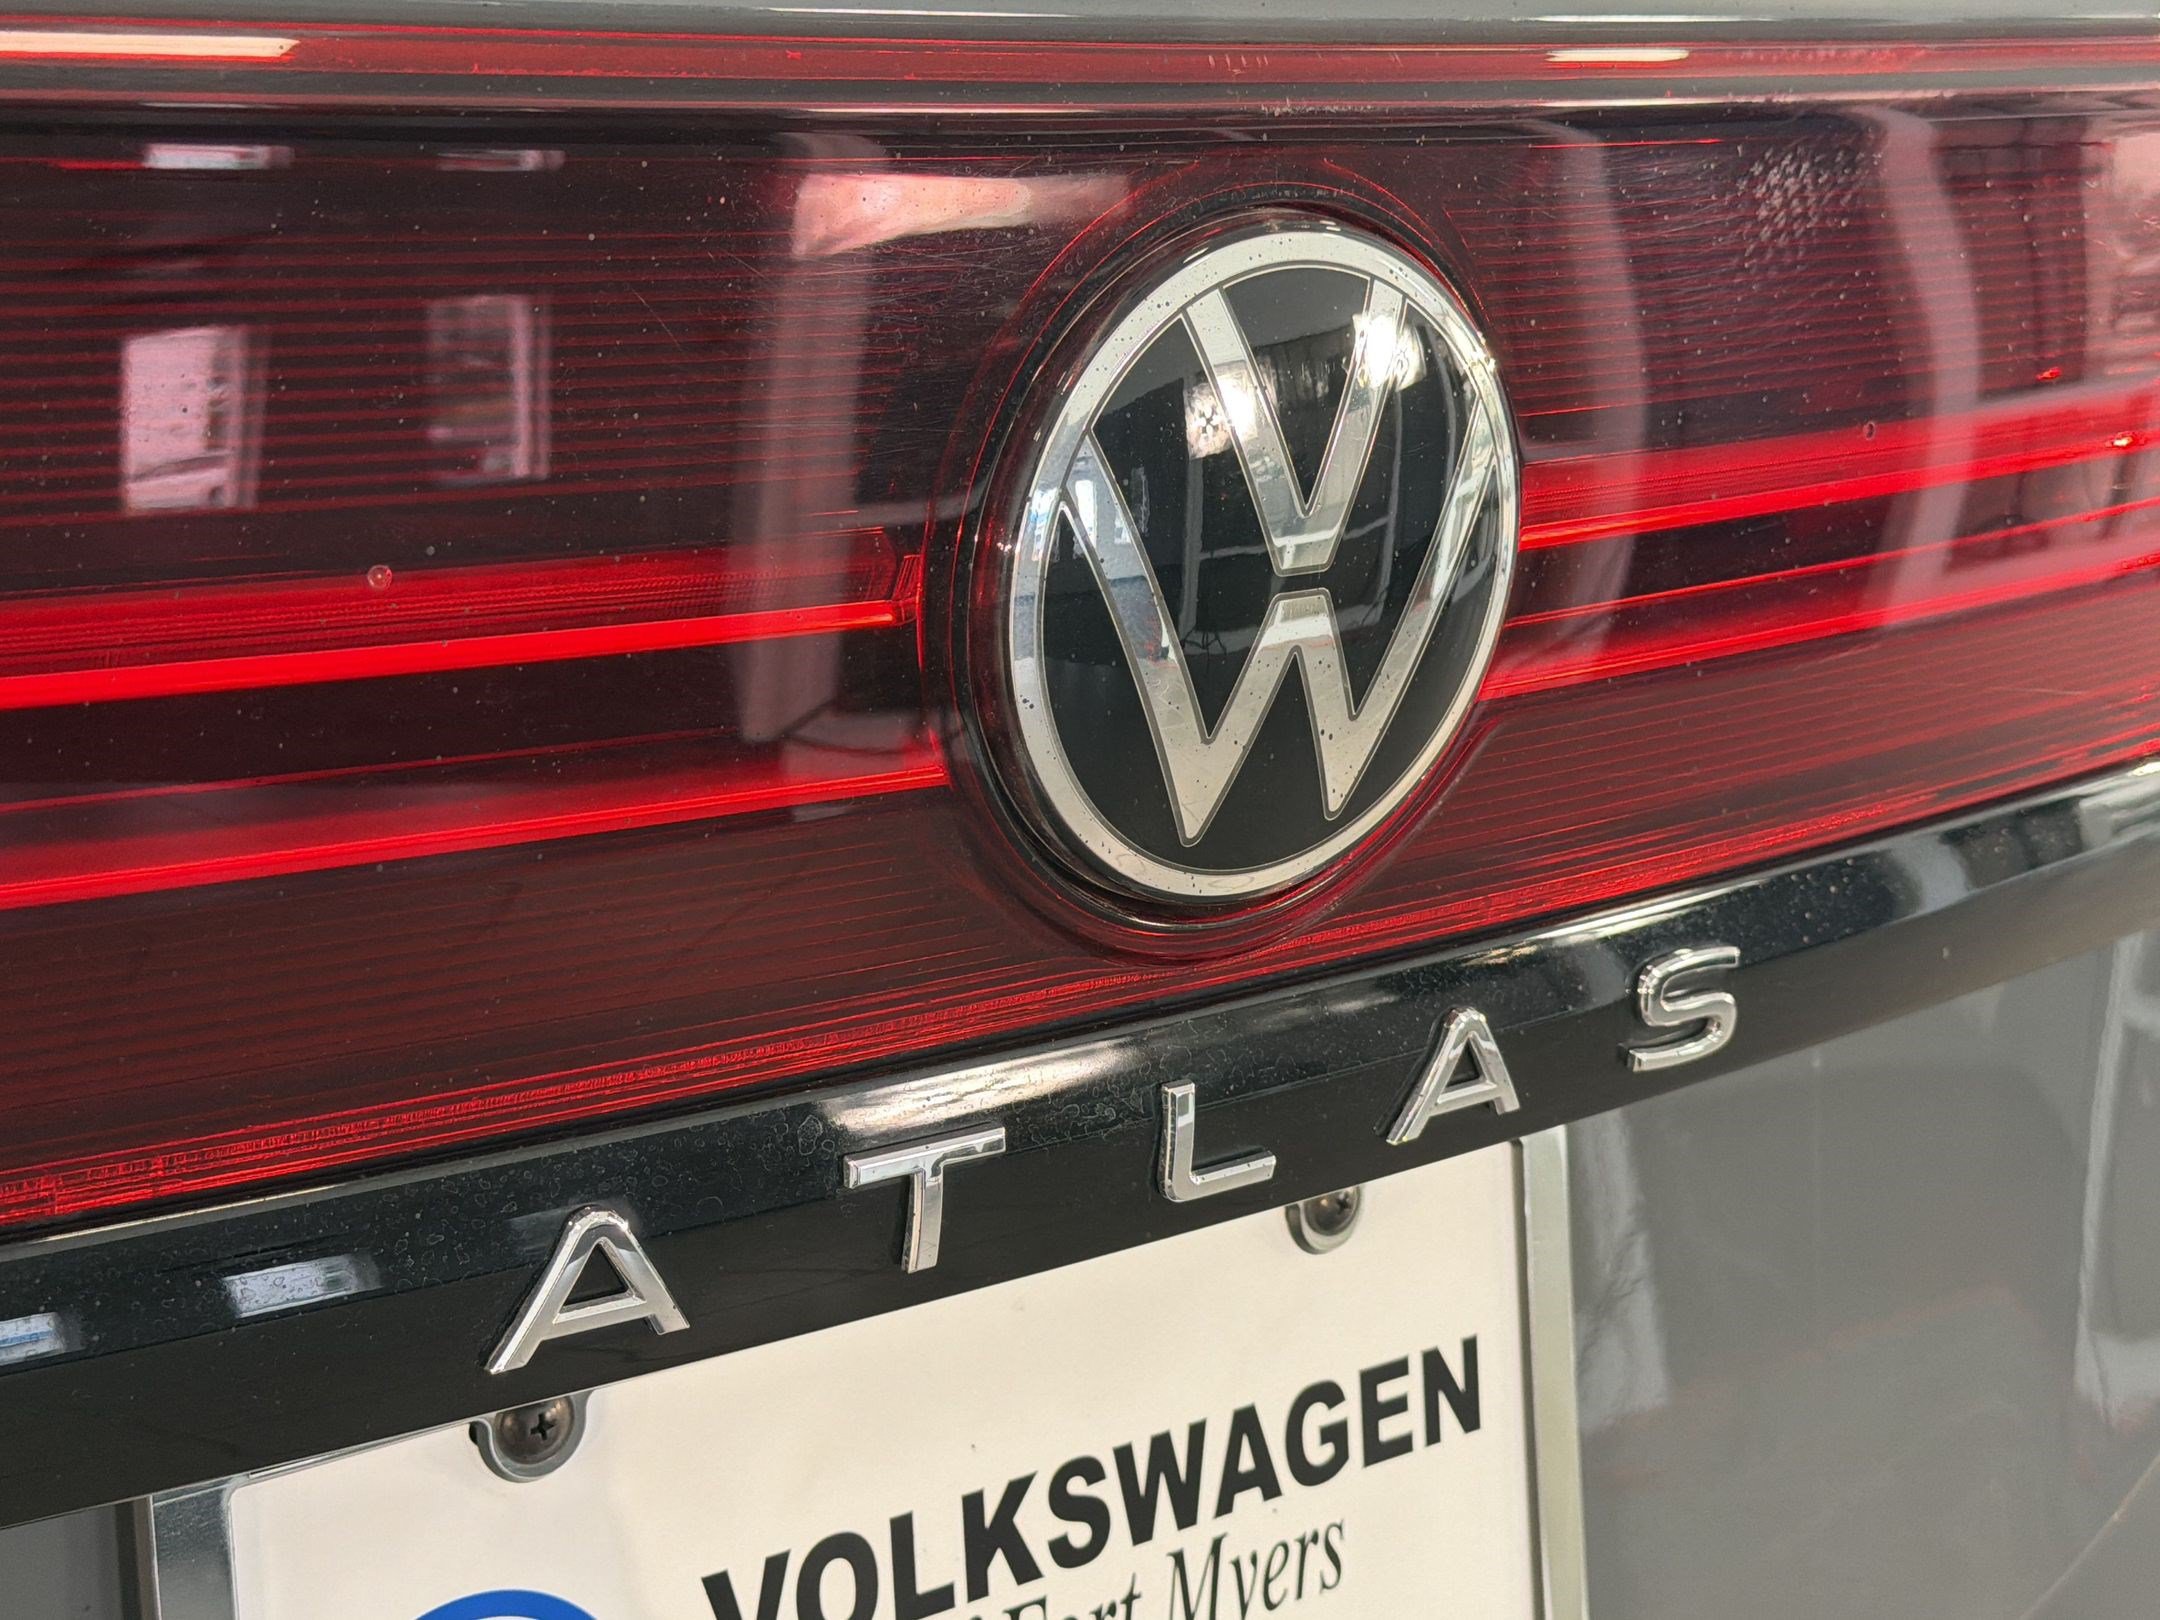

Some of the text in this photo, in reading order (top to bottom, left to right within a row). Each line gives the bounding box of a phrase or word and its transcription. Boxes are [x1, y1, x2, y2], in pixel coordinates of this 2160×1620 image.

[485, 945, 1742, 1375] ATLAS
[701, 1333, 1481, 1620] VOLKSWAGEN
[1166, 1518, 1345, 1620] Myers
